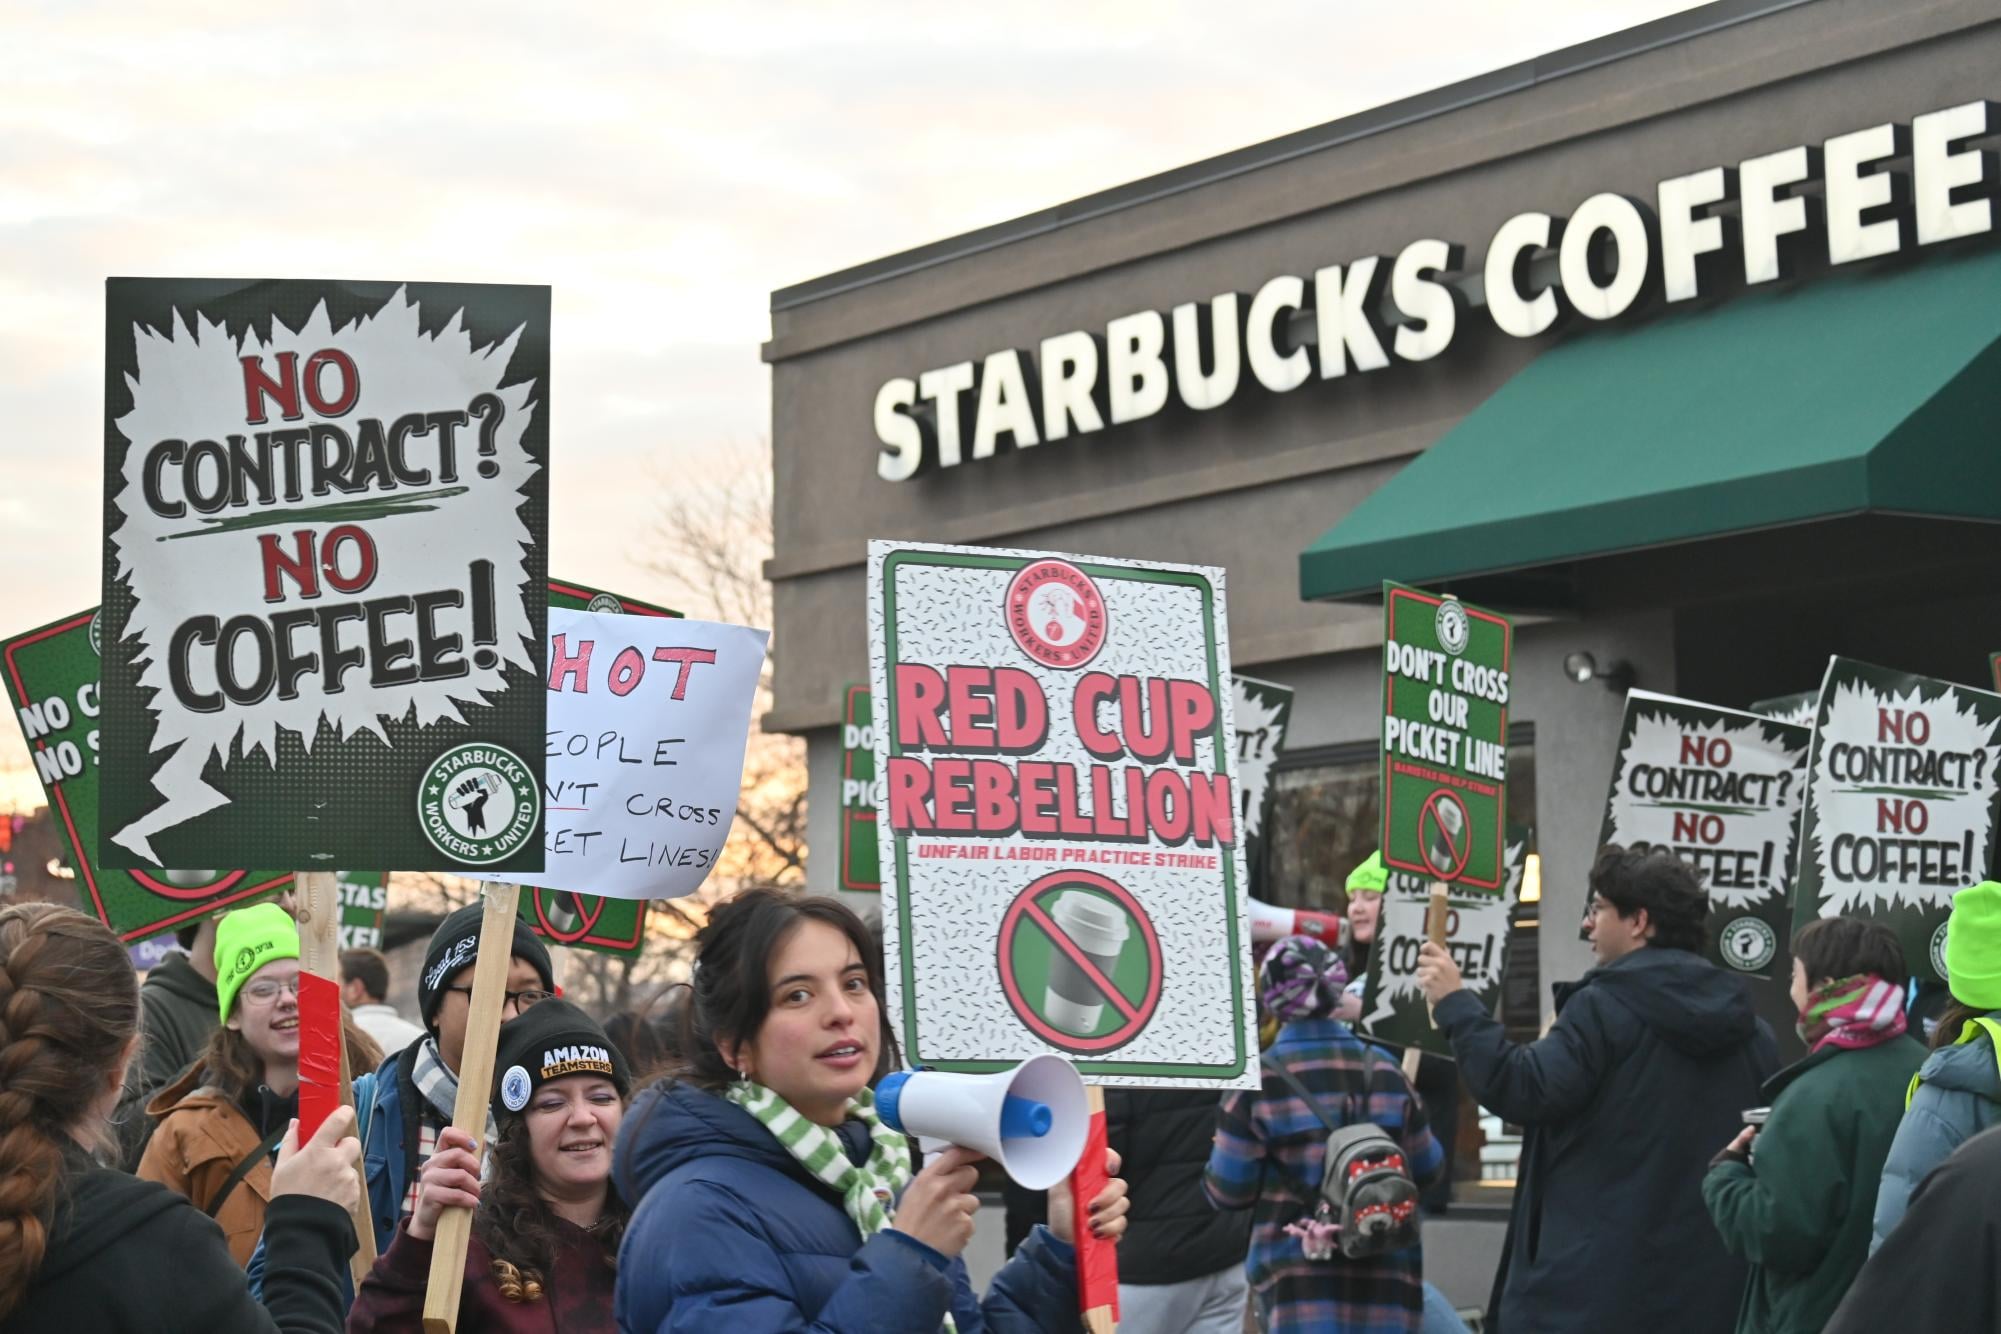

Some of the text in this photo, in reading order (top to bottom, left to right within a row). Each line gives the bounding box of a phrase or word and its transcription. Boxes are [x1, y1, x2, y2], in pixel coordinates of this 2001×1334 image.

[872, 100, 1994, 482] STARBUCKS COFFEE
[239, 348, 360, 424] NO
[142, 393, 505, 518] CONTRACT?
[258, 524, 378, 602] NO
[1019, 567, 1091, 598] STARBUCKS
[168, 559, 498, 713] COFFEE!
[1014, 604, 1061, 661] WORKERS
[1071, 610, 1099, 659] UNITED
[548, 632, 717, 701] HOT
[1387, 640, 1509, 704] DON'T CROSS
[19, 695, 71, 739] NO
[895, 662, 1218, 766] RED CUP
[1428, 689, 1469, 729] OUR
[1878, 707, 1931, 746] NO
[34, 740, 83, 784] NO
[435, 750, 524, 782] STARBUCKS
[545, 731, 686, 766] EOPLE
[1385, 716, 1505, 780] PICKET LINE
[1680, 735, 1733, 768] NO
[1828, 742, 1988, 791] CONTRACT?
[545, 780, 721, 825] N'T CROSS
[887, 756, 1236, 848] REBELLION
[1628, 763, 1794, 807] CONTRACT?
[425, 801, 479, 857] WORKERS
[494, 801, 533, 851] UNITED
[1672, 812, 1726, 845] NO
[1877, 798, 1929, 835] NO
[620, 838, 718, 869] LINES!
[918, 844, 1217, 869] UNFAIR LABOR PRACTICE STRIKE
[1831, 829, 1974, 887] COFFEE!
[543, 1059, 612, 1077] TEAMSTERS
[544, 1045, 610, 1068] AMAZON
